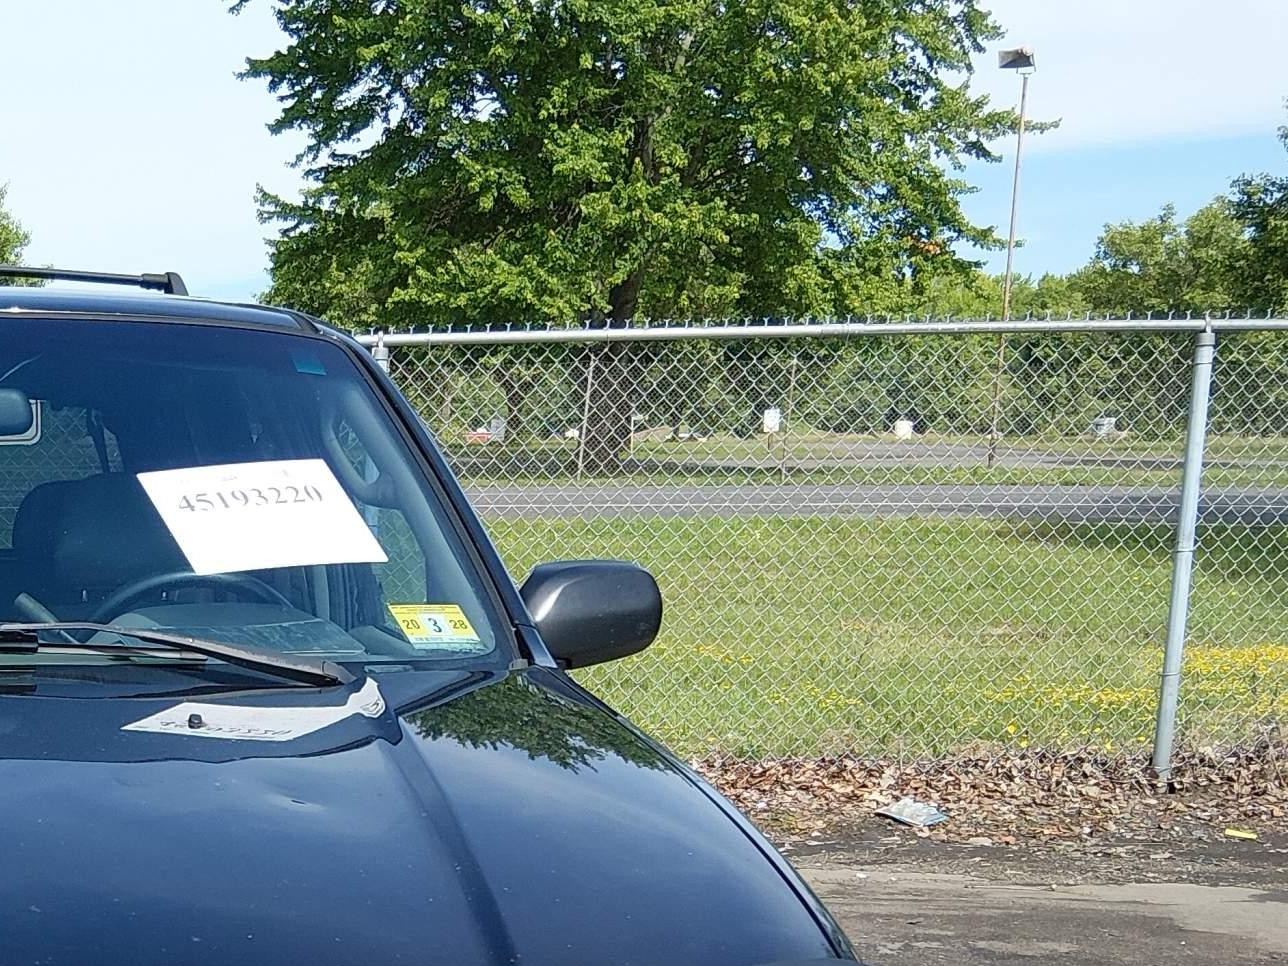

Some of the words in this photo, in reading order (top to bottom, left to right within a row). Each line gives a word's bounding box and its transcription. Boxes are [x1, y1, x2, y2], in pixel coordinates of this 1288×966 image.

[178, 484, 323, 512] 45193220
[402, 619, 420, 630] 20
[427, 617, 443, 633] 3
[449, 619, 468, 630] 28
